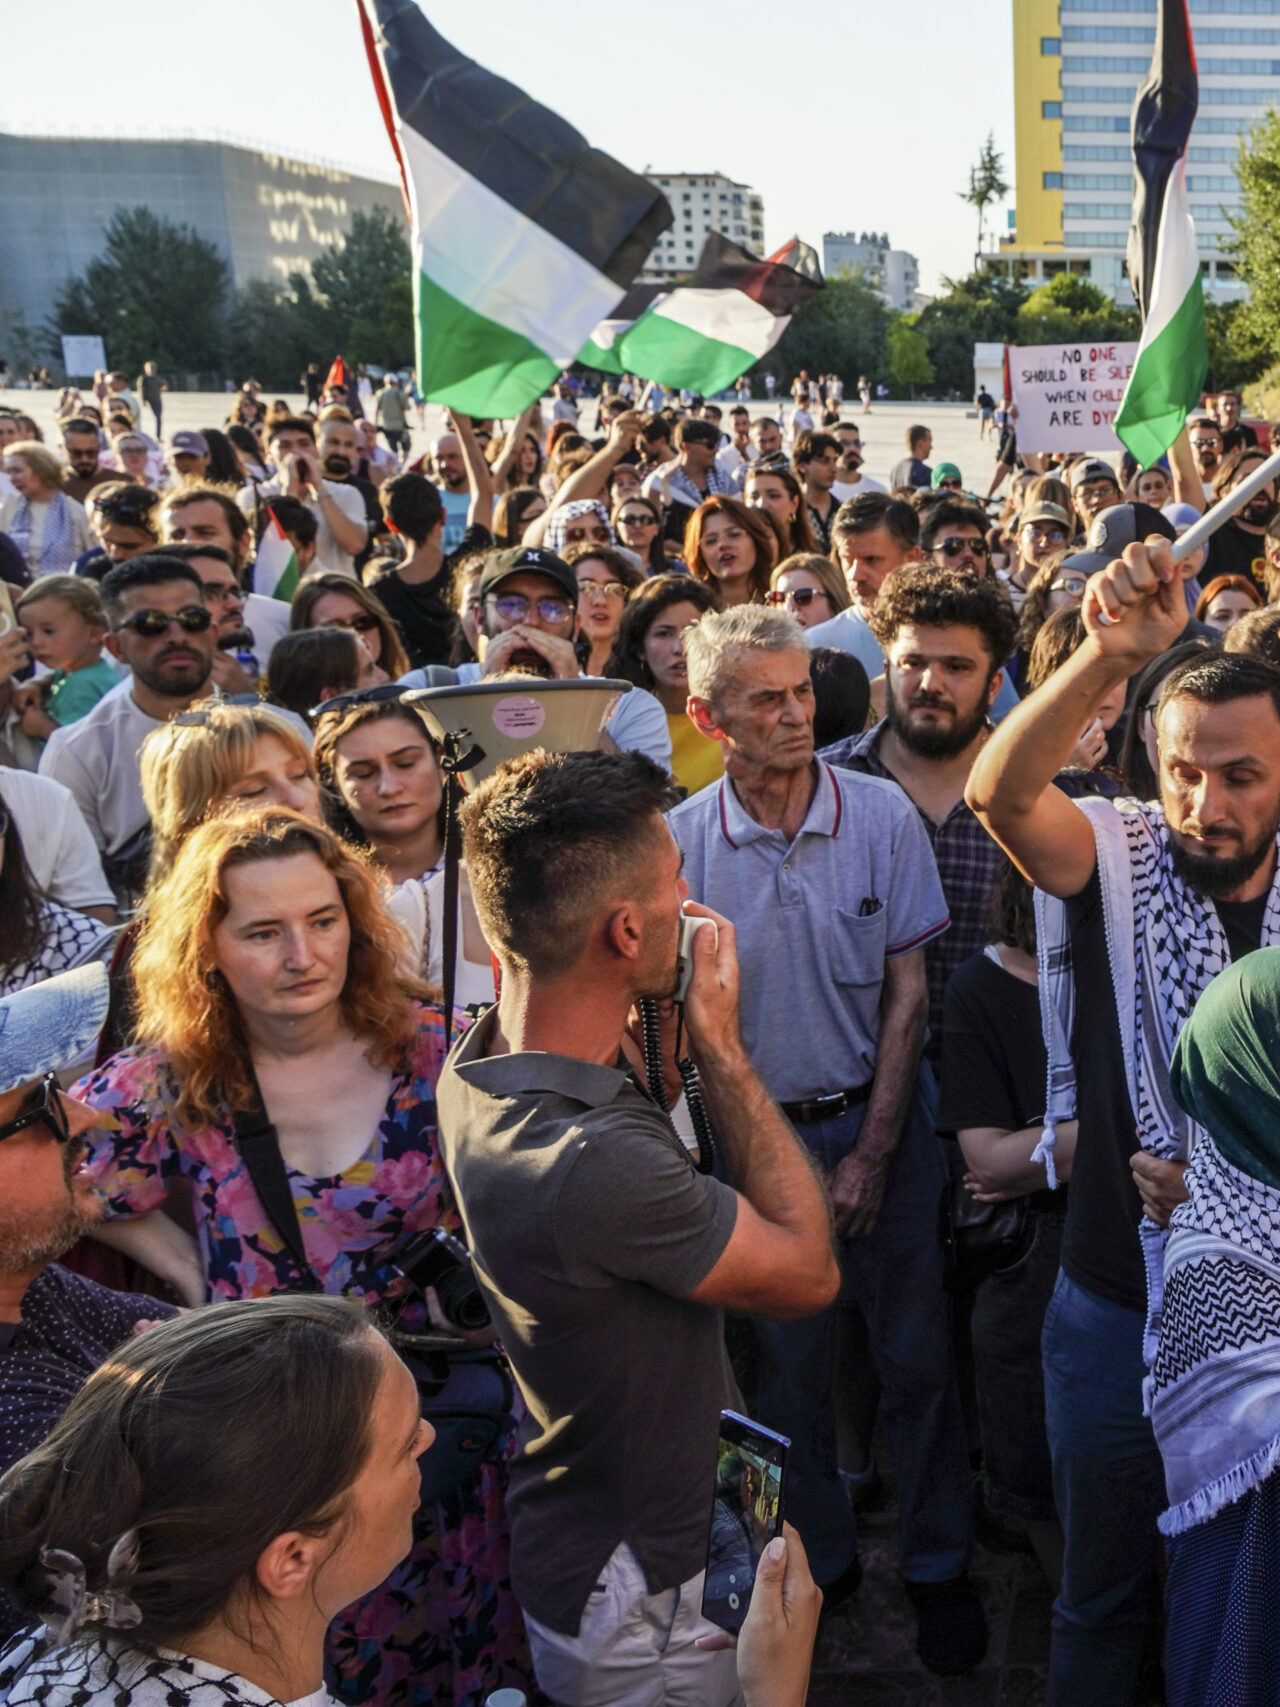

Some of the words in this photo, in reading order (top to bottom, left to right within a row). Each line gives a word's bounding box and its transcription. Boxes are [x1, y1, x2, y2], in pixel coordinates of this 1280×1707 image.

[1062, 349, 1081, 364] NO
[1090, 346, 1116, 363] ONE
[1022, 369, 1067, 383] SHOULD
[1081, 368, 1096, 382] BE
[1108, 365, 1133, 380] SILE
[1045, 390, 1086, 404] WHEN
[1093, 388, 1123, 402] CHILD
[1049, 410, 1083, 426] ARE
